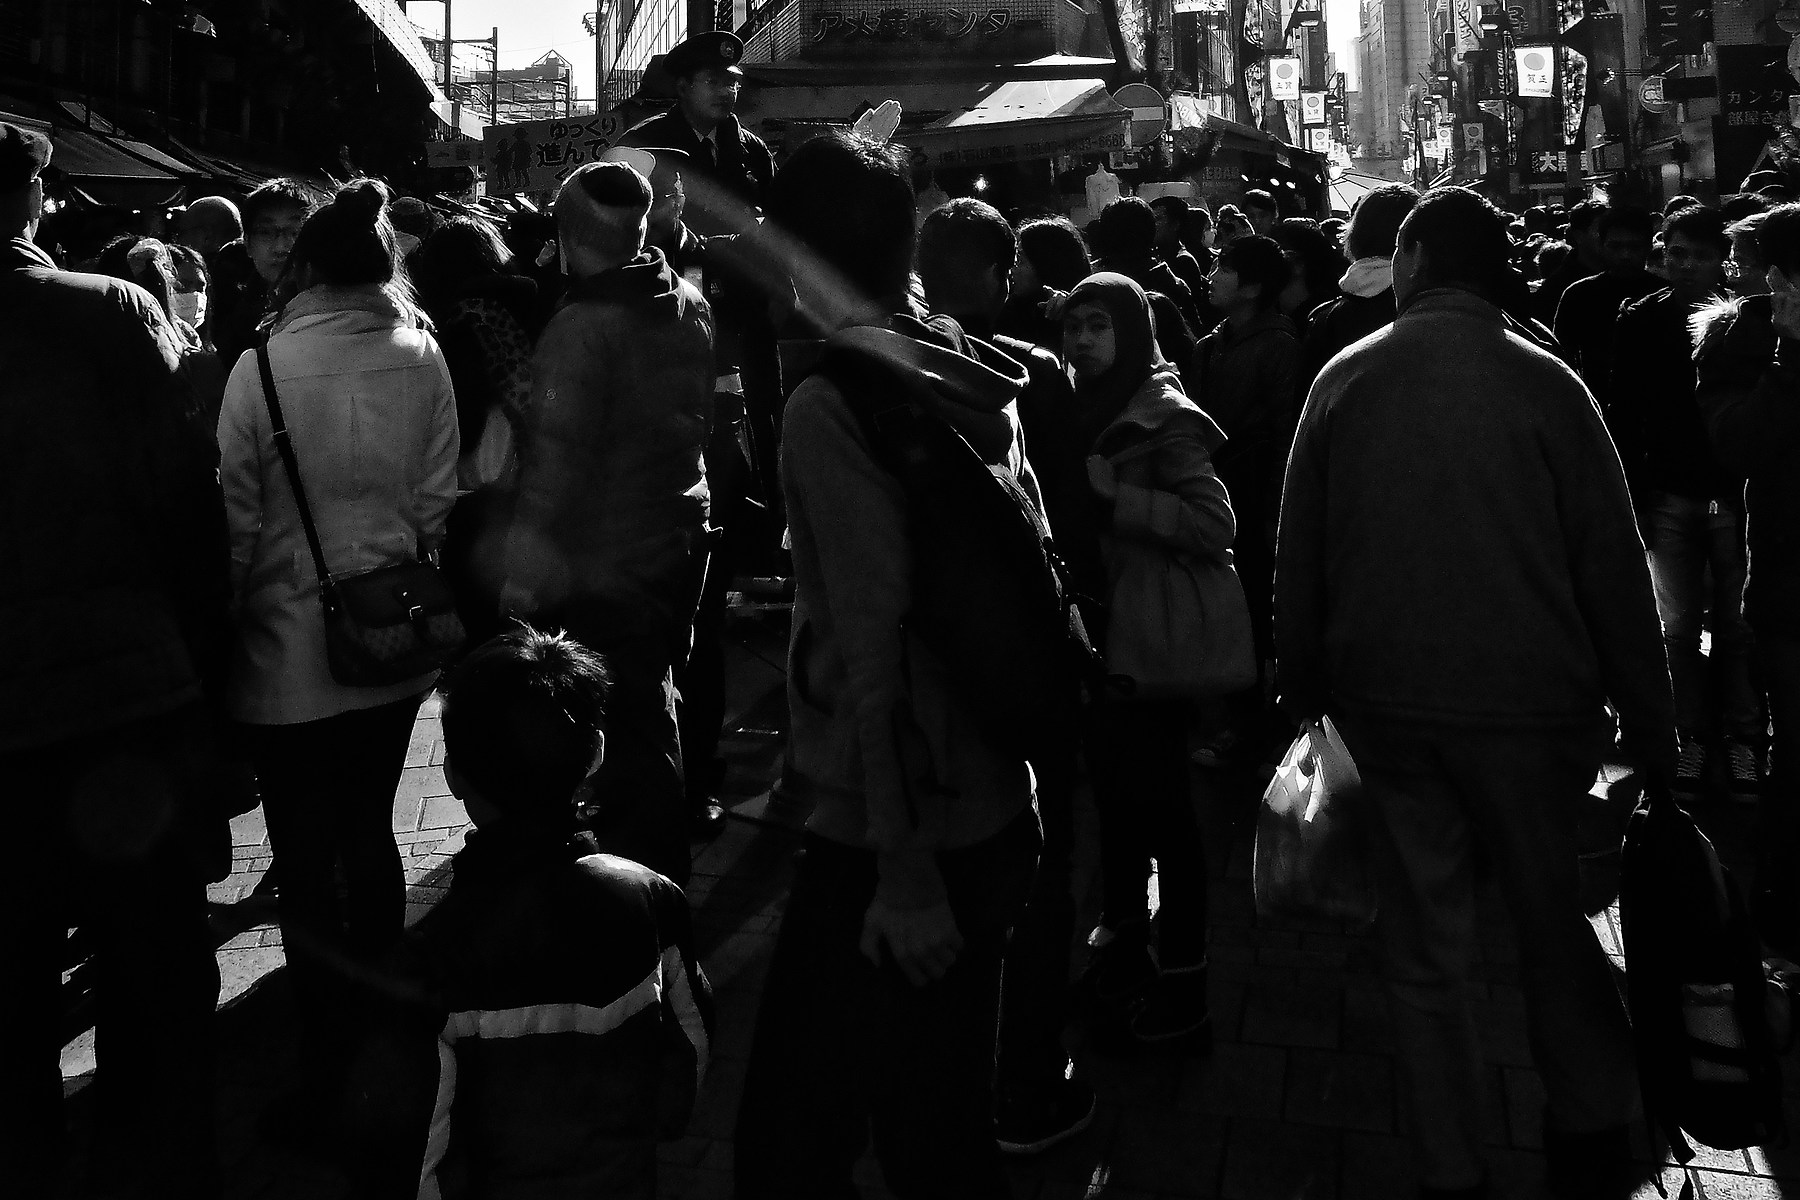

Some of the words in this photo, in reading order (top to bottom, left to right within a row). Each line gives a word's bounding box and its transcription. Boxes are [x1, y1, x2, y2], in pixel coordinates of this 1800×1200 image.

[549, 117, 617, 140] ゆっくり
[535, 138, 611, 167] 進んで
